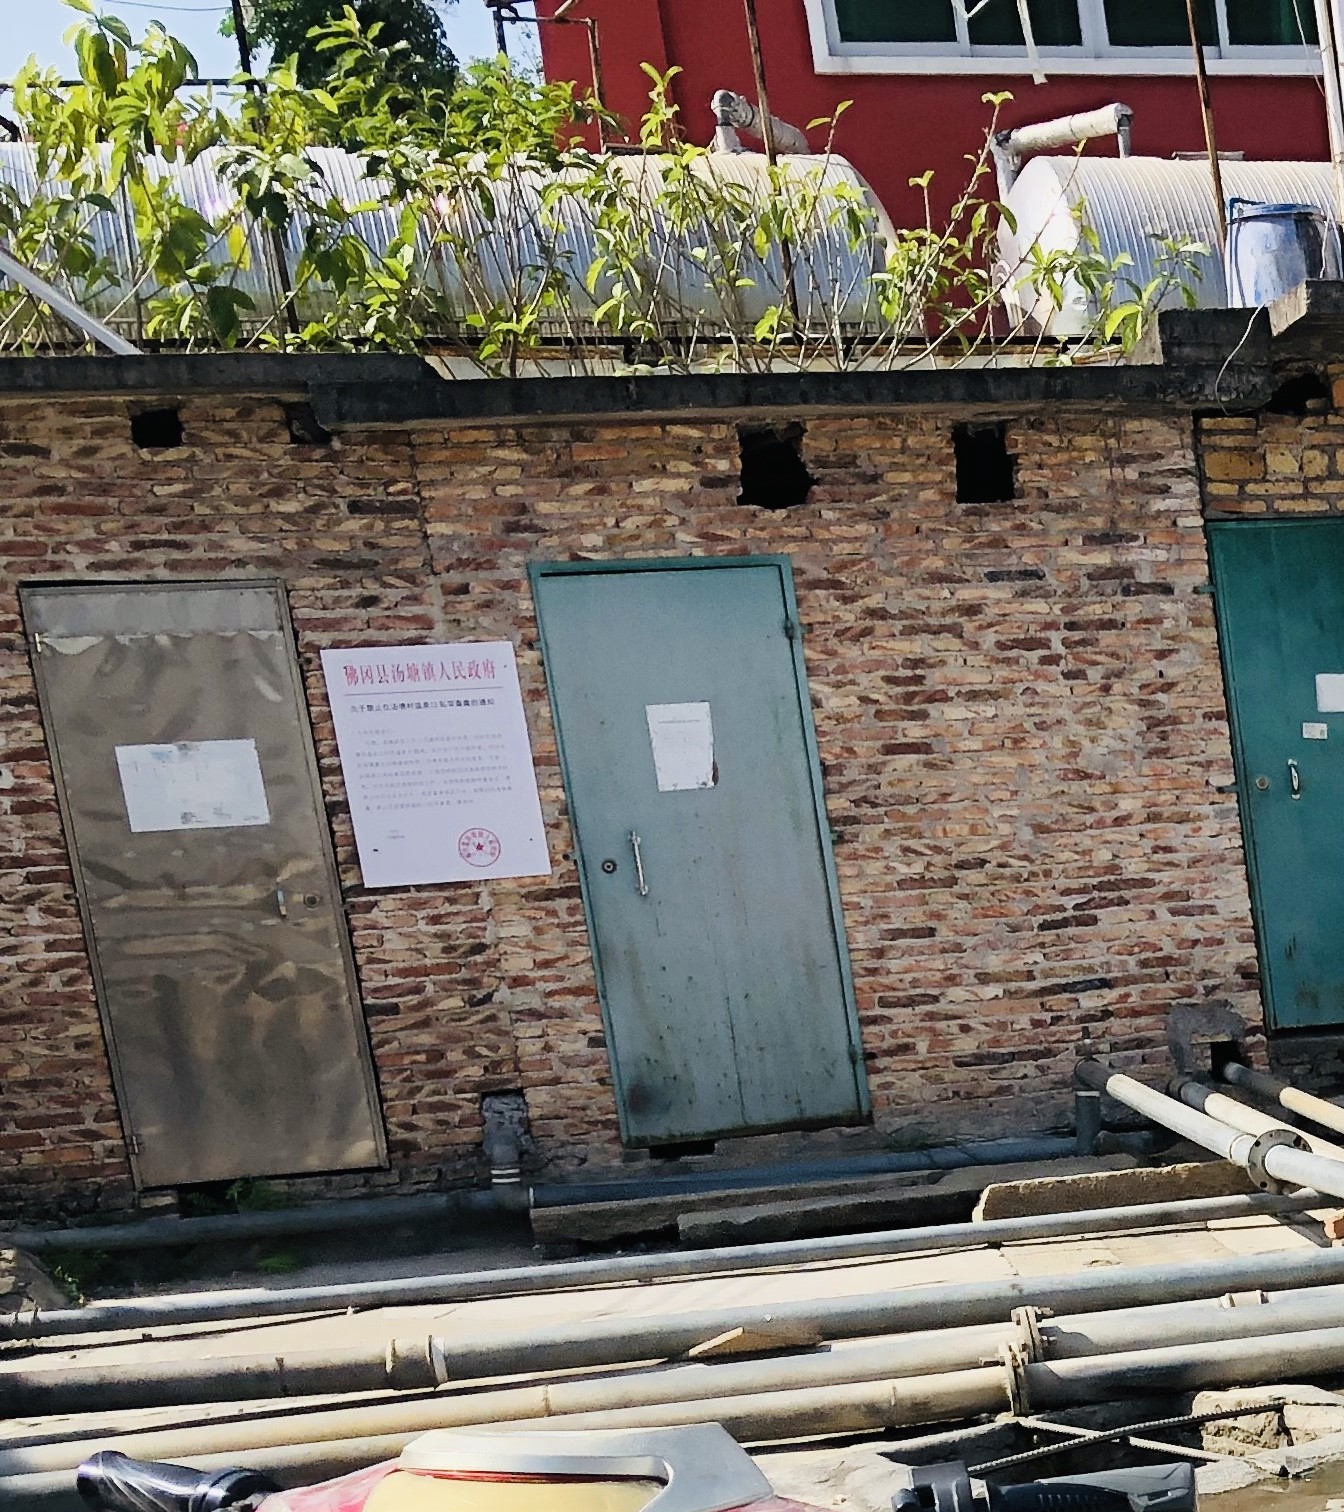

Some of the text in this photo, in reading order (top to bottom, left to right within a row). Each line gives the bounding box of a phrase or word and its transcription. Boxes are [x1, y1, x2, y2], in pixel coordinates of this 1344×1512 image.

[343, 657, 496, 687] 佛冈县汤塘镇人民政府
